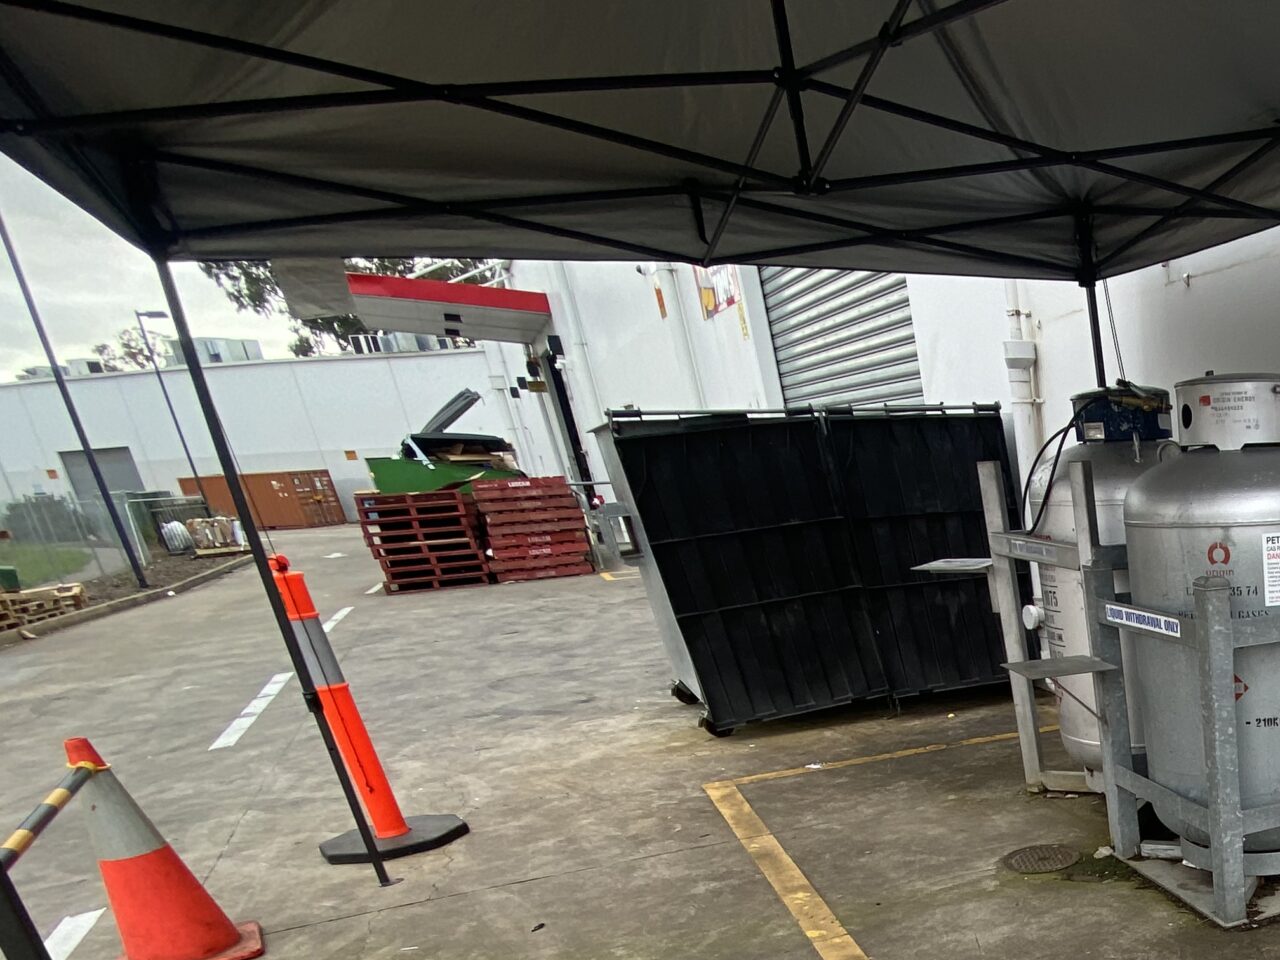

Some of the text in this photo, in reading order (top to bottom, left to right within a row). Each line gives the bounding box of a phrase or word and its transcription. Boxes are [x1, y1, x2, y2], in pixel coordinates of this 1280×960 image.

[1206, 569, 1234, 577] origin
[1106, 606, 1123, 621] LIQUID
[1125, 611, 1163, 631] WITHDRAWAL
[1164, 620, 1179, 635] ONLY
